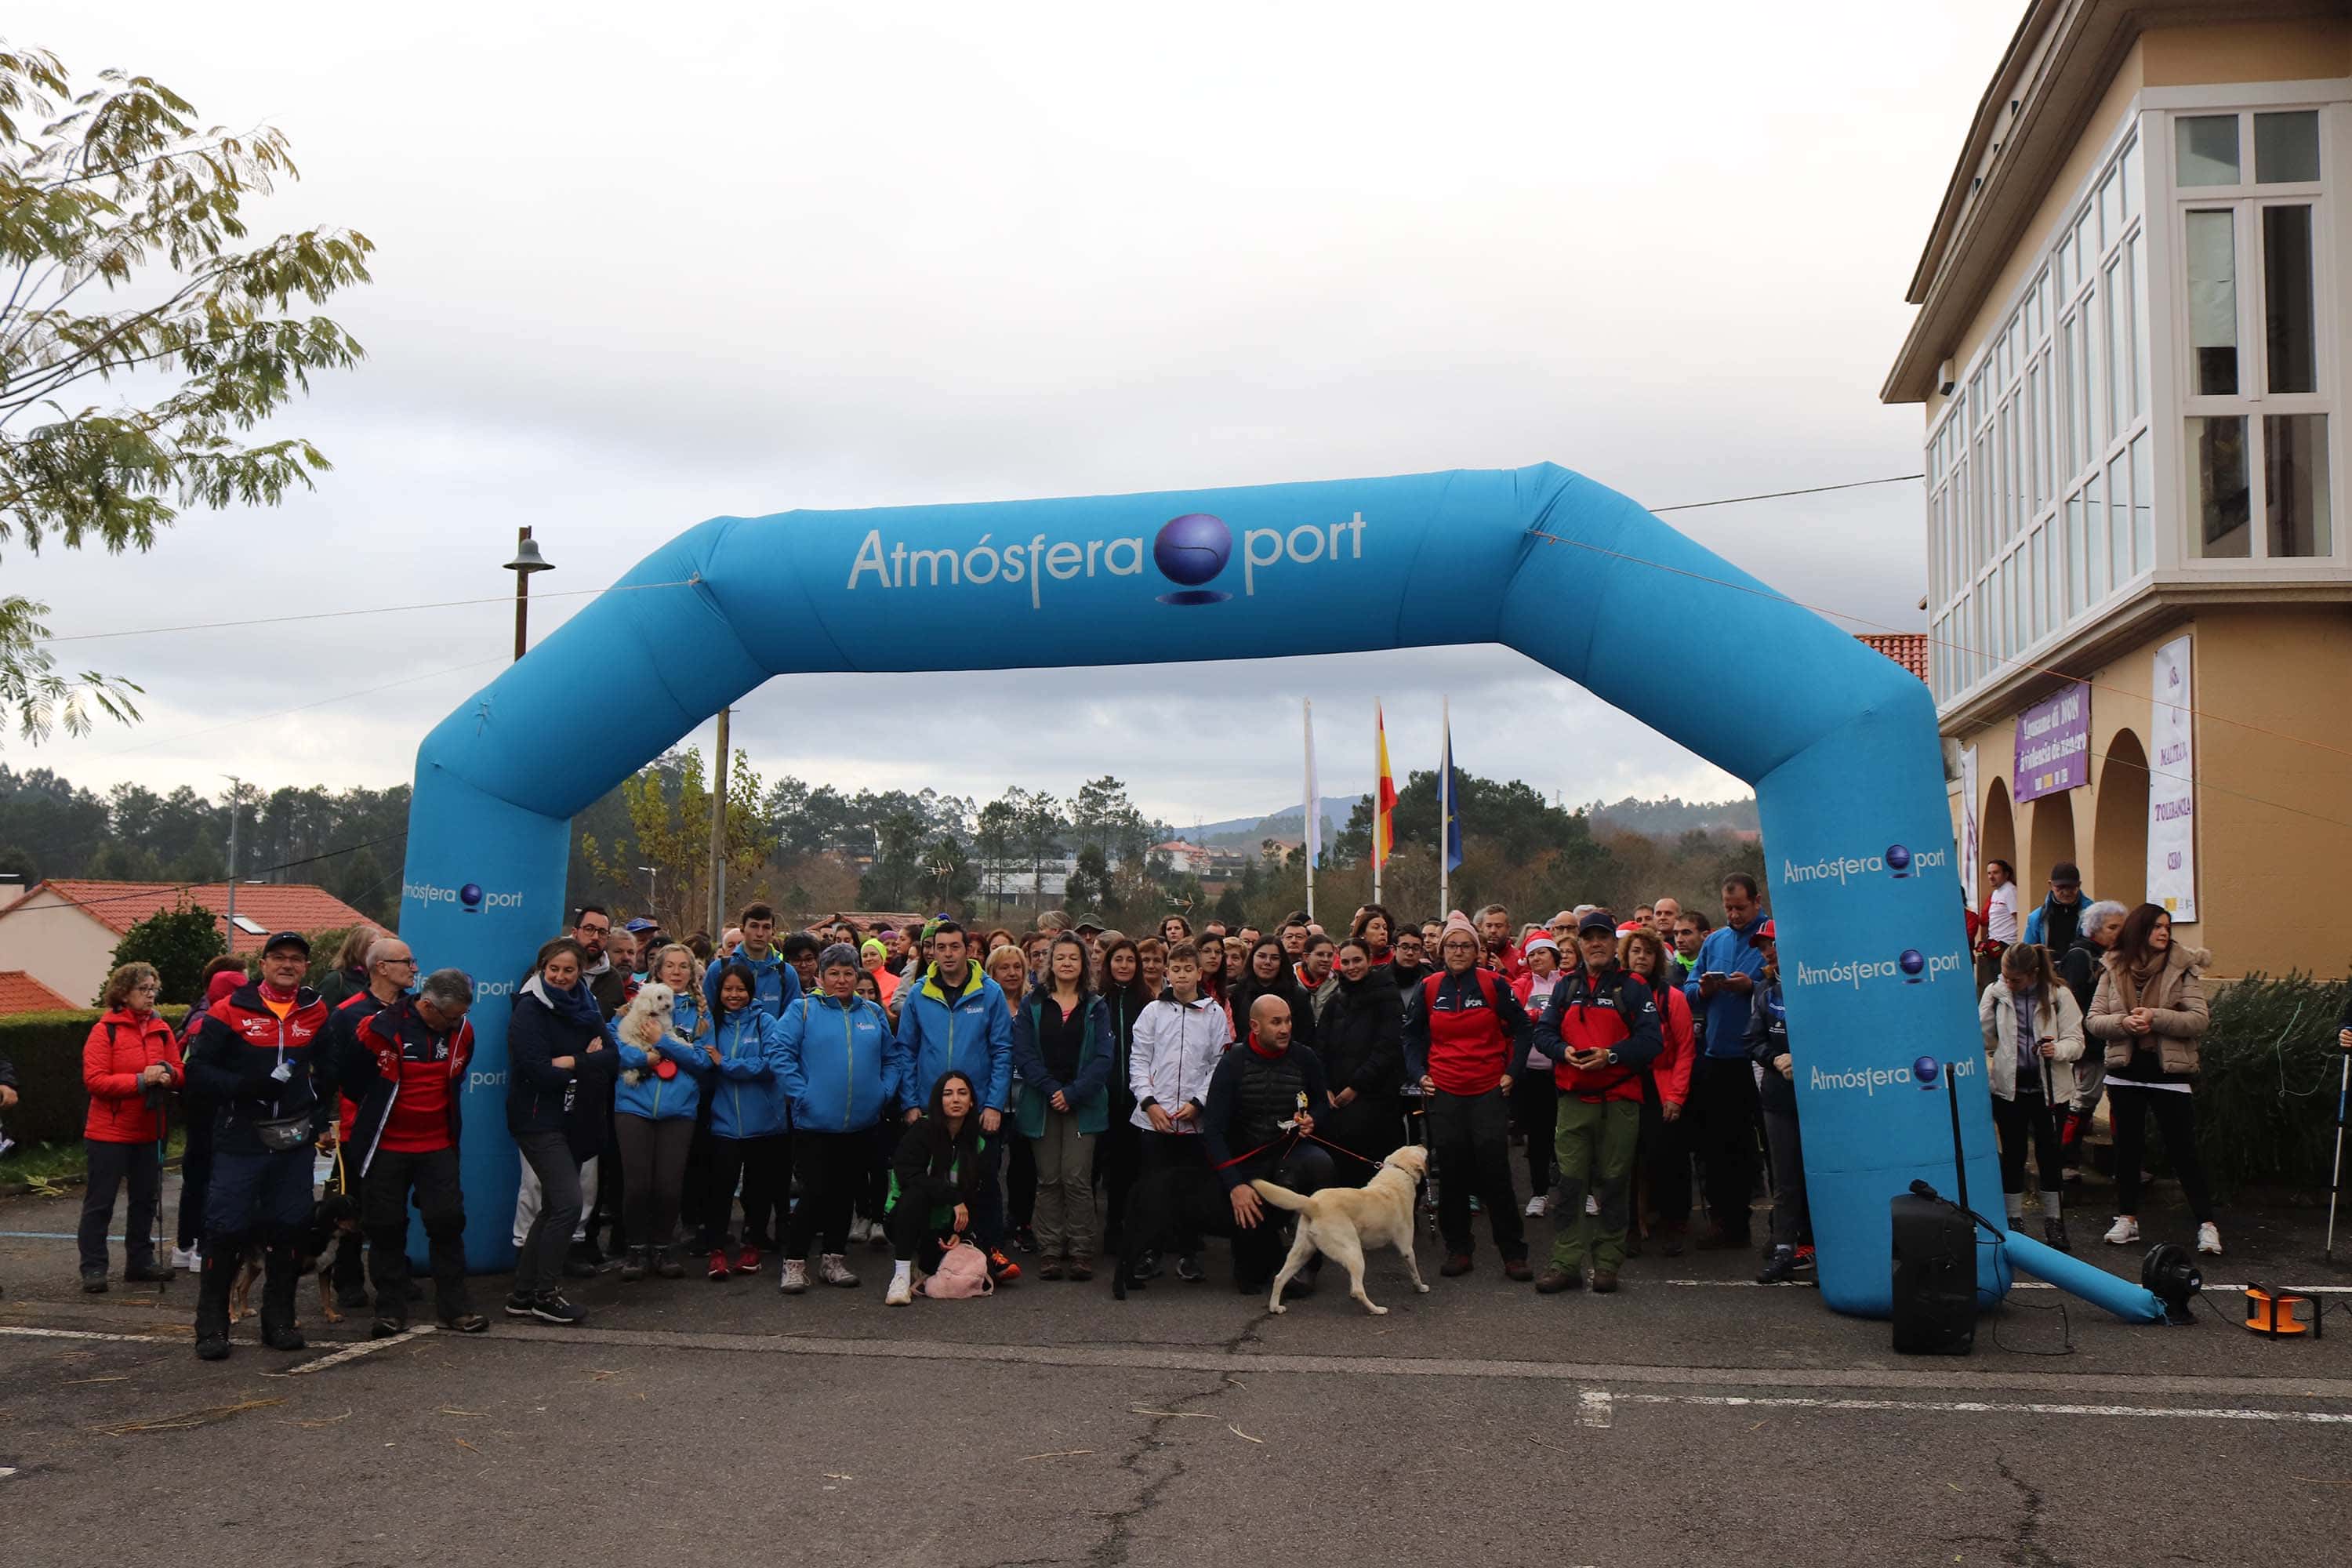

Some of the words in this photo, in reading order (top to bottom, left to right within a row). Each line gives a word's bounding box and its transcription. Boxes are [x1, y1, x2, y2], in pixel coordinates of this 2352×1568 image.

[847, 529, 1143, 609] Atmósfera
[2061, 694, 2080, 724] NON
[1784, 856, 1882, 886] Atmósfera
[1798, 960, 1897, 990] Atmósfera
[1811, 1065, 1911, 1097] Atmósfera
